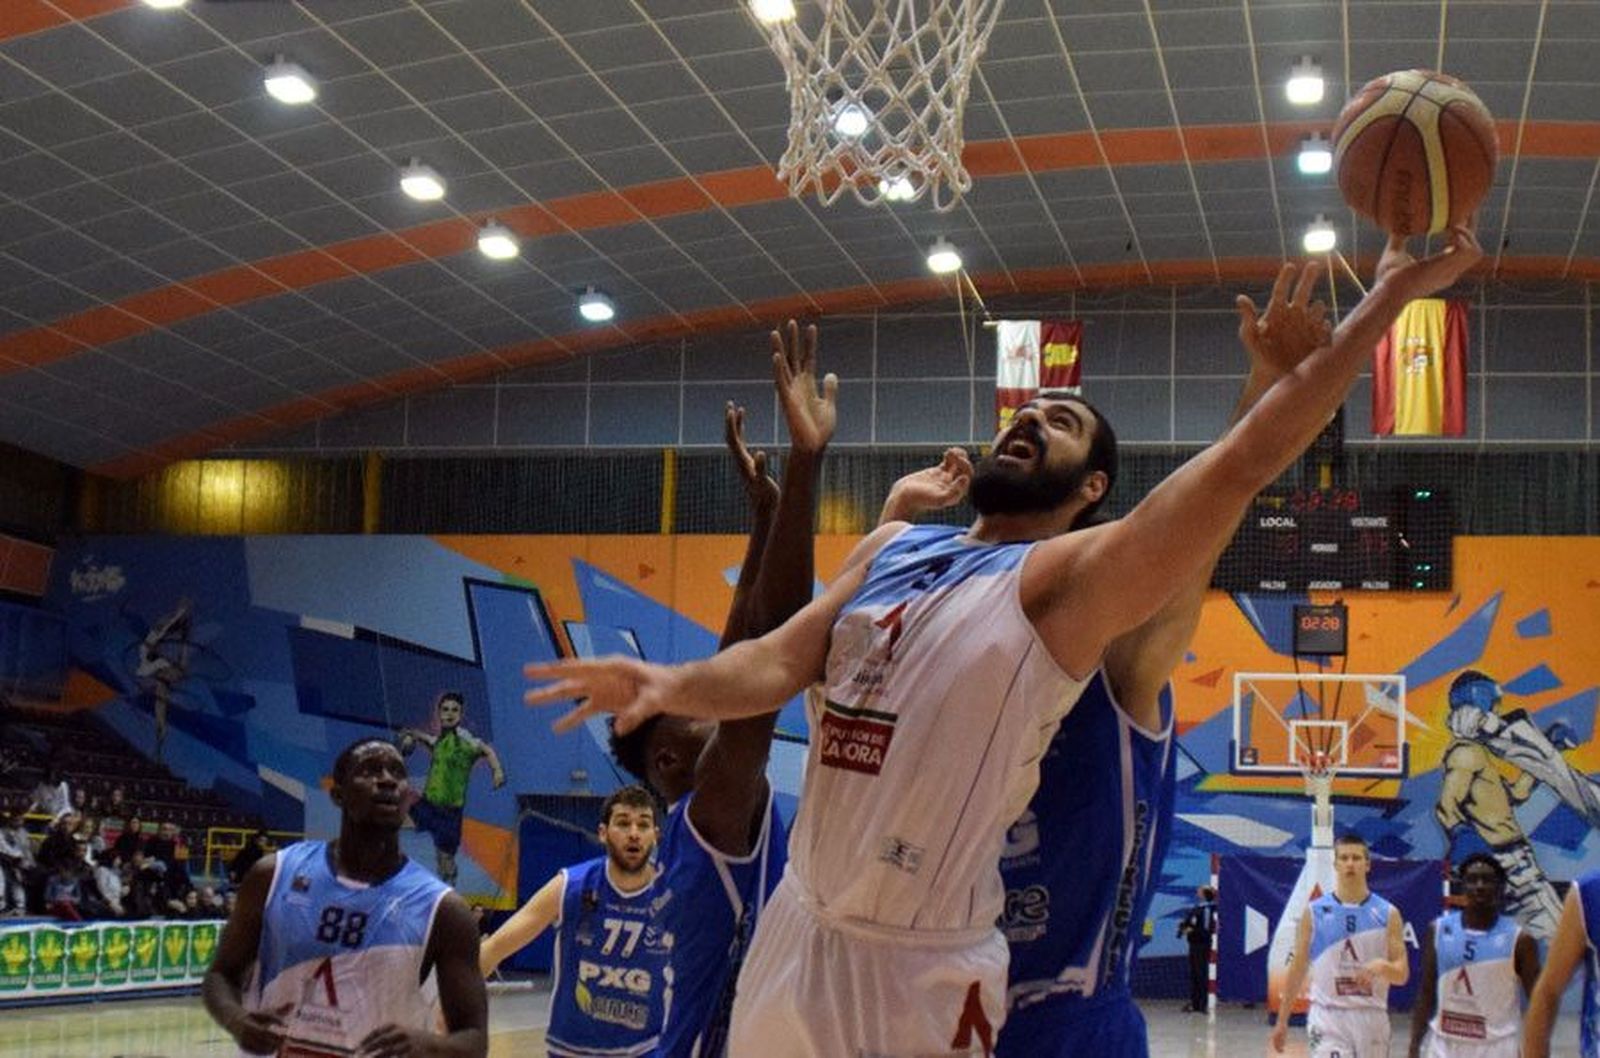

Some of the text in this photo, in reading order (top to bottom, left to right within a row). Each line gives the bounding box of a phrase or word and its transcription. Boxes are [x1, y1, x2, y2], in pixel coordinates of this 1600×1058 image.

[1260, 517, 1297, 528] LOCAL
[822, 737, 882, 766] ZAORA
[316, 906, 369, 949] 88
[601, 918, 645, 958] 77
[1463, 941, 1477, 961] 5
